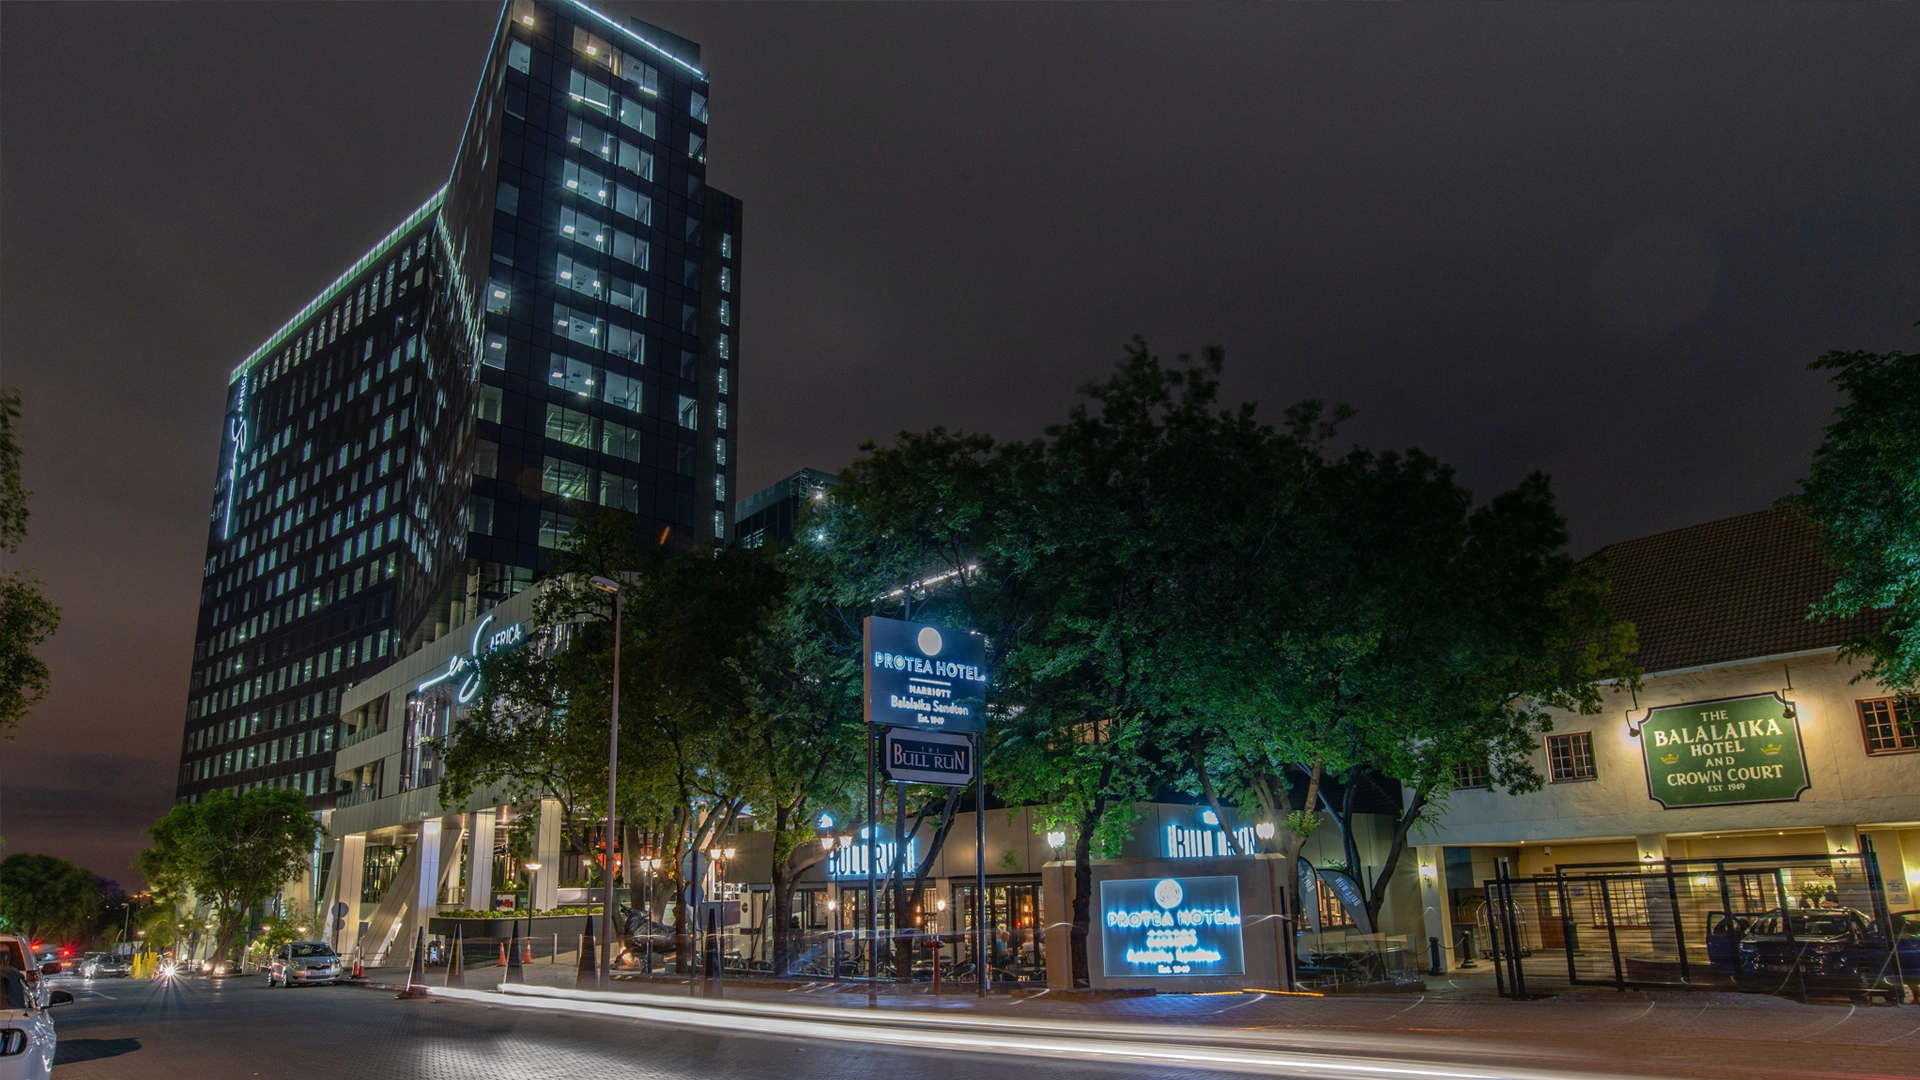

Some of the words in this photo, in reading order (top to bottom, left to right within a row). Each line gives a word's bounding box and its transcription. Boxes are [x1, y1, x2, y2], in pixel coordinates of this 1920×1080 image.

[489, 623, 522, 651] AFRICA
[875, 651, 934, 675] PROTEA
[909, 684, 952, 698] MARRIOTT
[932, 699, 969, 715] Sandton
[1700, 709, 1729, 722] THE
[1653, 718, 1784, 747] BALALAIKA
[920, 746, 940, 754] THE
[1690, 740, 1745, 757] HOTEL
[1705, 756, 1735, 768] AND
[1666, 769, 1723, 787] CROWN
[1726, 764, 1784, 782] COURT
[1707, 784, 1724, 793] EST
[1727, 782, 1746, 791] 1949
[1107, 910, 1175, 928] PROTEA
